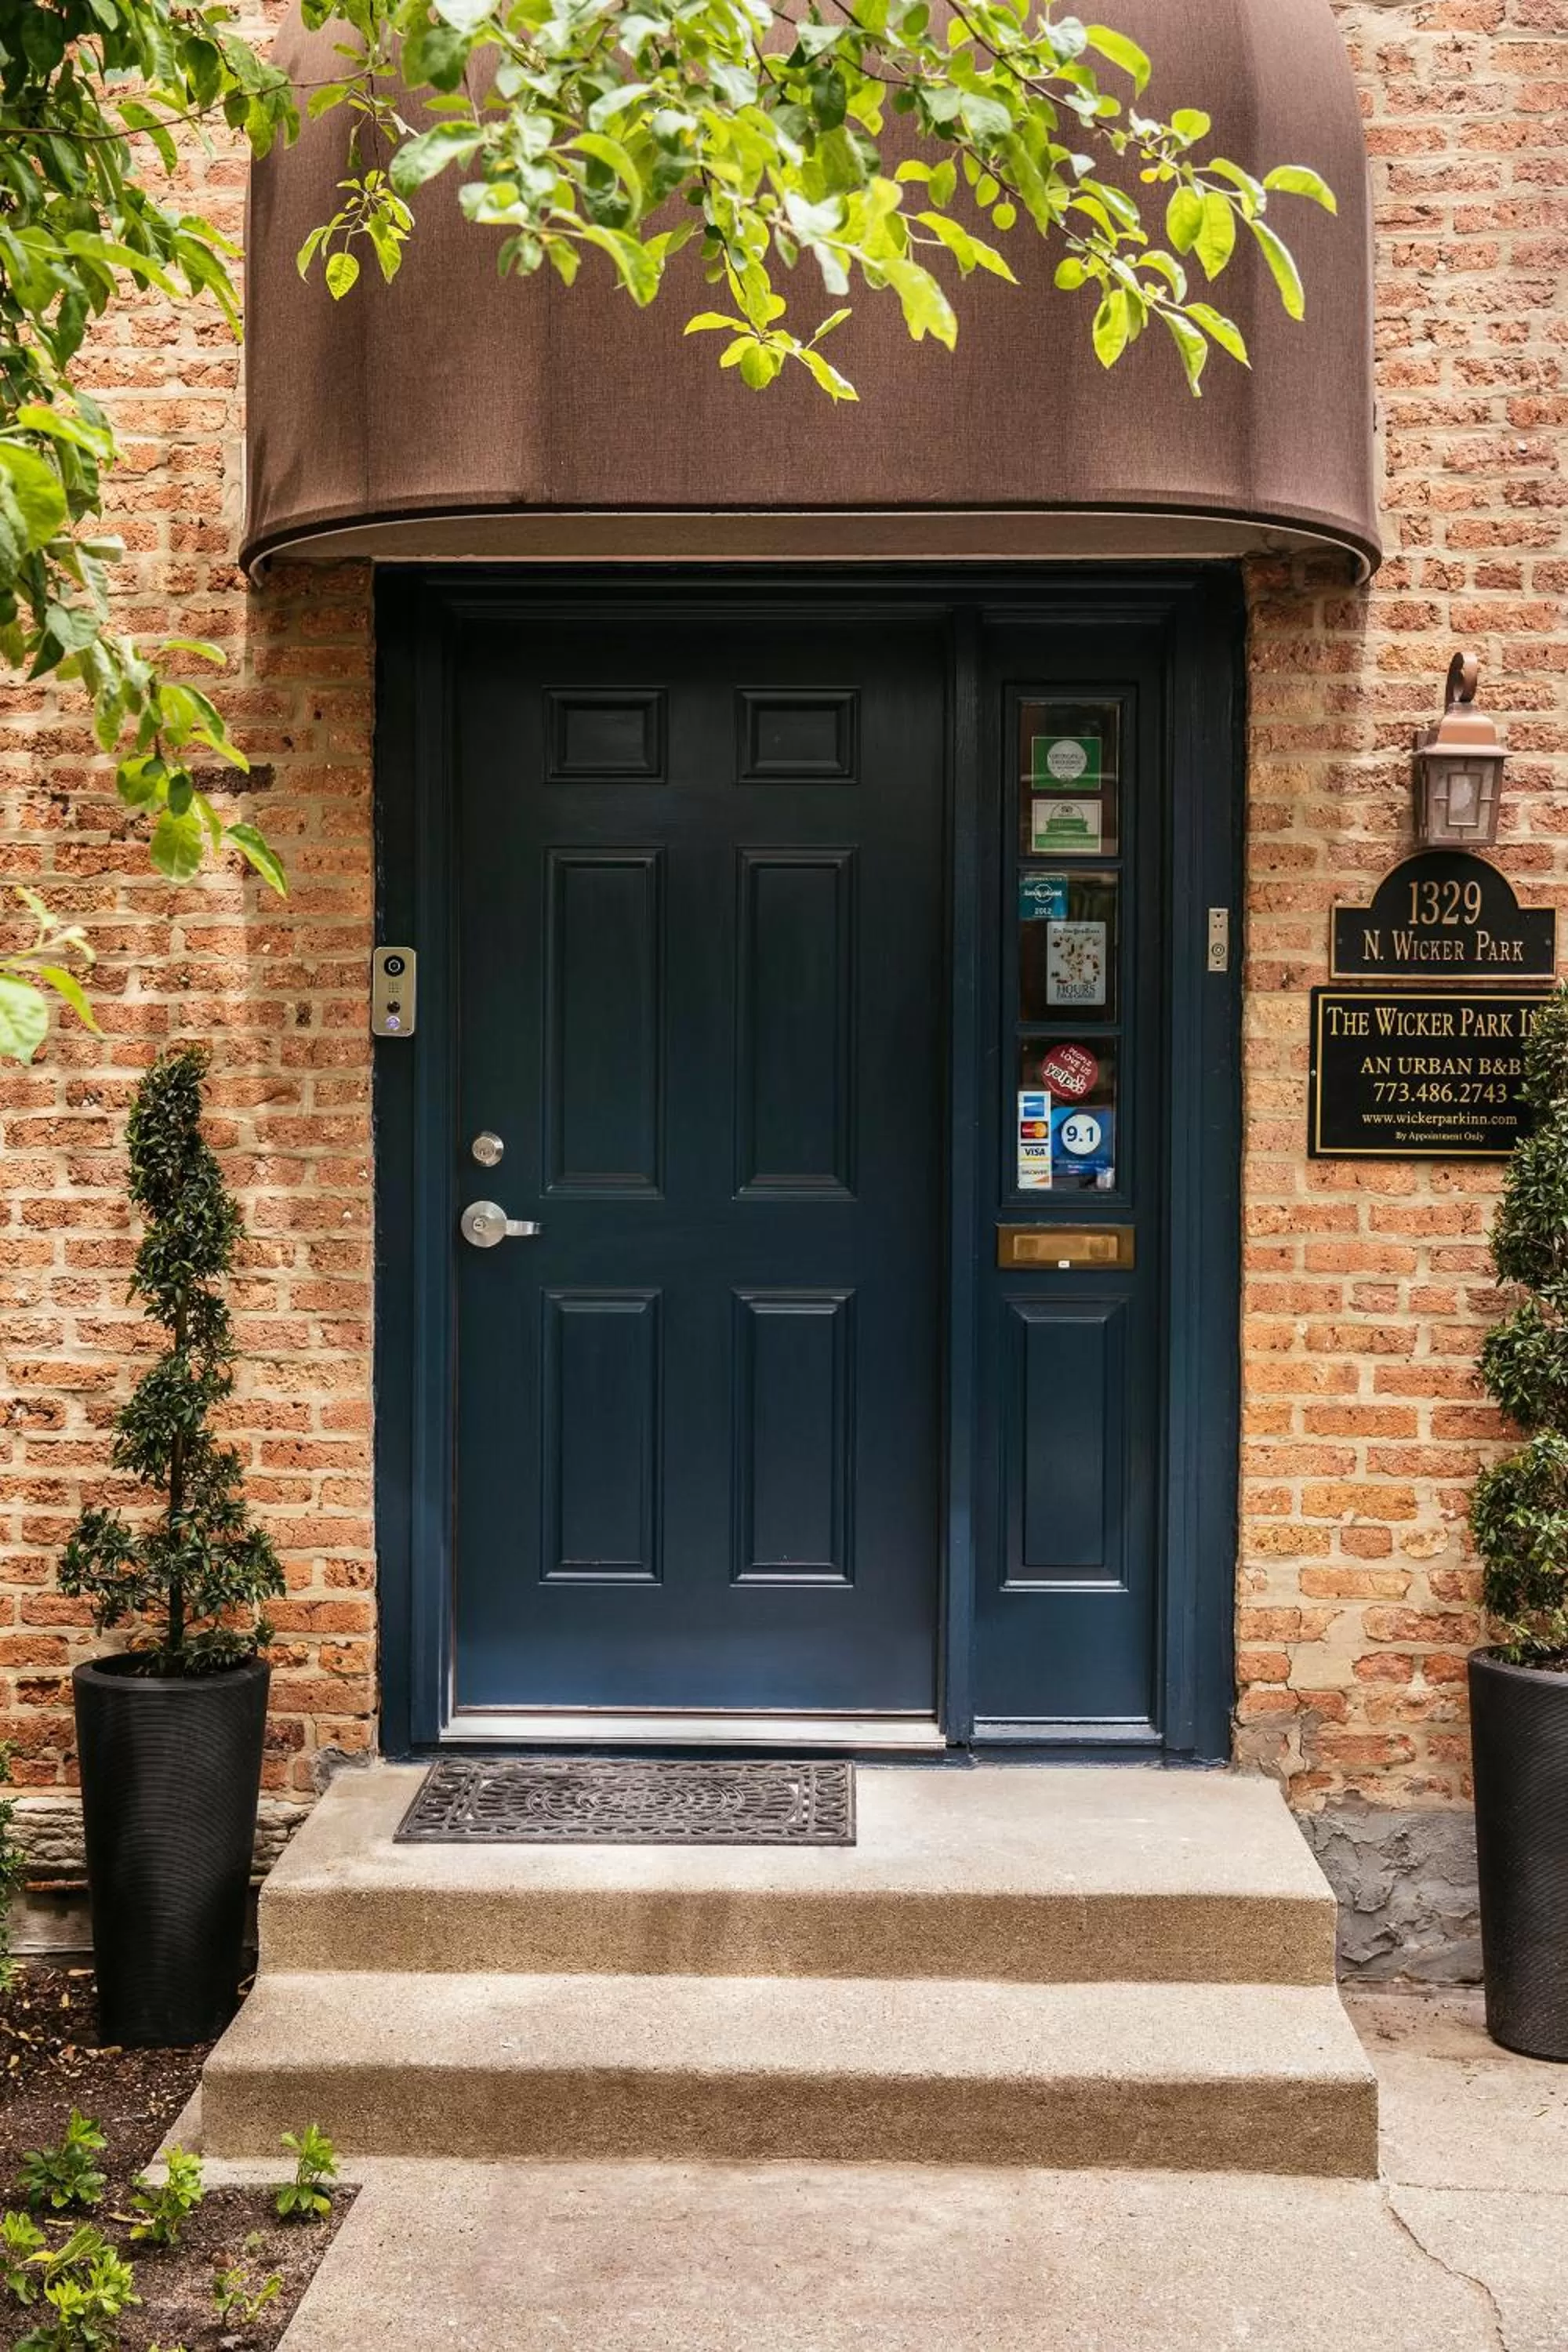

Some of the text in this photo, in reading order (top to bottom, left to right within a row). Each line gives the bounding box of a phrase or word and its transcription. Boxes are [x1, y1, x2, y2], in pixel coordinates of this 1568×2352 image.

[1408, 880, 1483, 925] 1329
[1362, 929, 1524, 962] N. WICKER PARK
[1327, 1006, 1370, 1036] THE
[1375, 1007, 1454, 1036] WICKER
[1460, 1008, 1514, 1037] PARK
[1060, 1049, 1080, 1068] LOVE
[1360, 1057, 1522, 1076] AN URBAN B&B
[1045, 1063, 1073, 1087] yelp
[1374, 1083, 1508, 1103] 773.486.2743
[1362, 1112, 1518, 1127] www.wickerparkinn.com
[1066, 1125, 1094, 1142] 9.1
[1396, 1131, 1485, 1142] By Appointment Only
[1025, 1148, 1045, 1156] VISA
